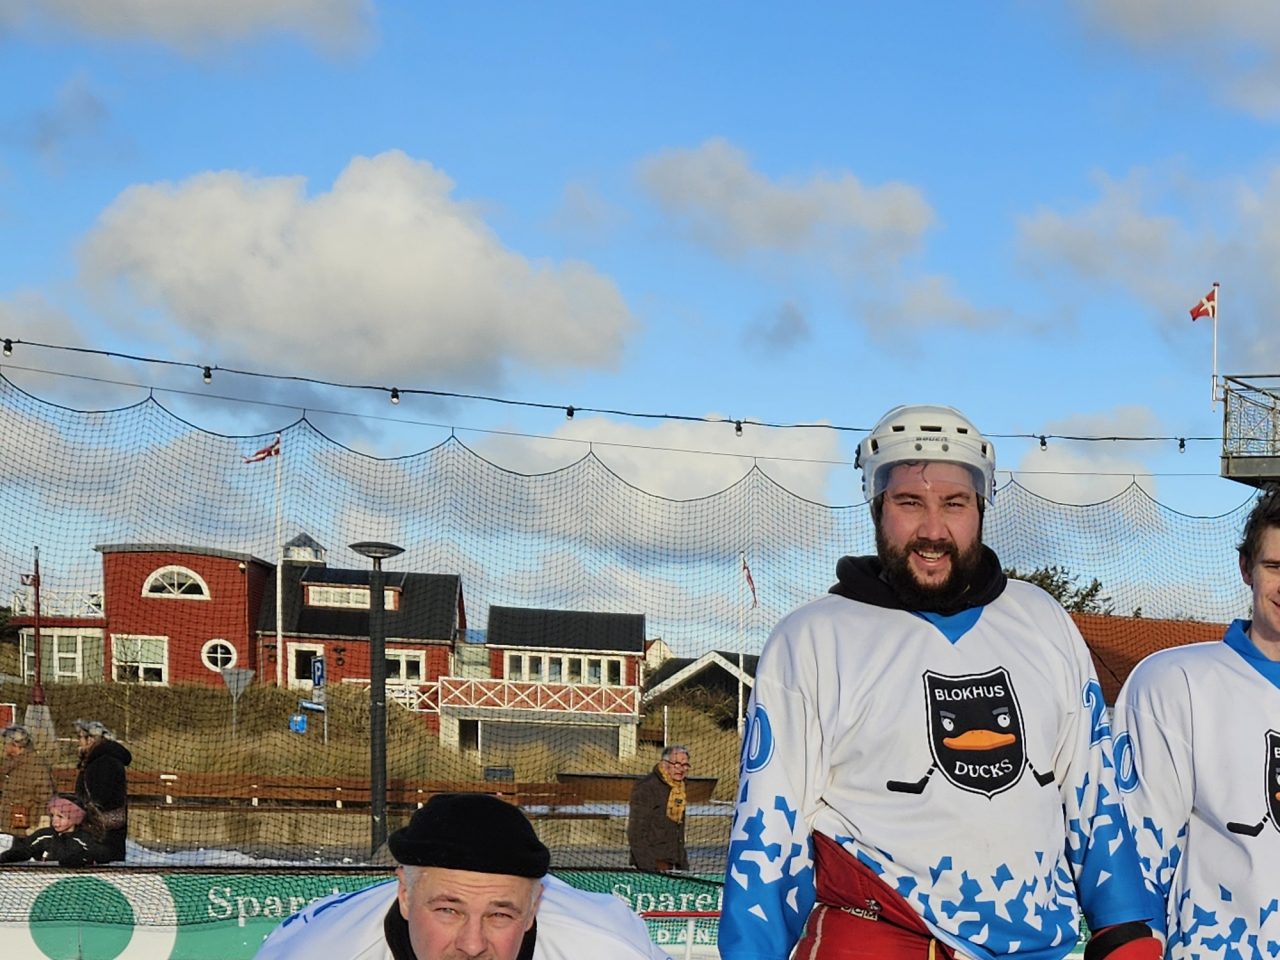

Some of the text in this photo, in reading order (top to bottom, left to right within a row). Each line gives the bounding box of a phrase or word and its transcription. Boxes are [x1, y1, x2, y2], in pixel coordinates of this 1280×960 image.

[934, 685, 1006, 701] BLOKHUS
[954, 758, 1013, 779] DUCKS
[207, 884, 339, 928] Spar
